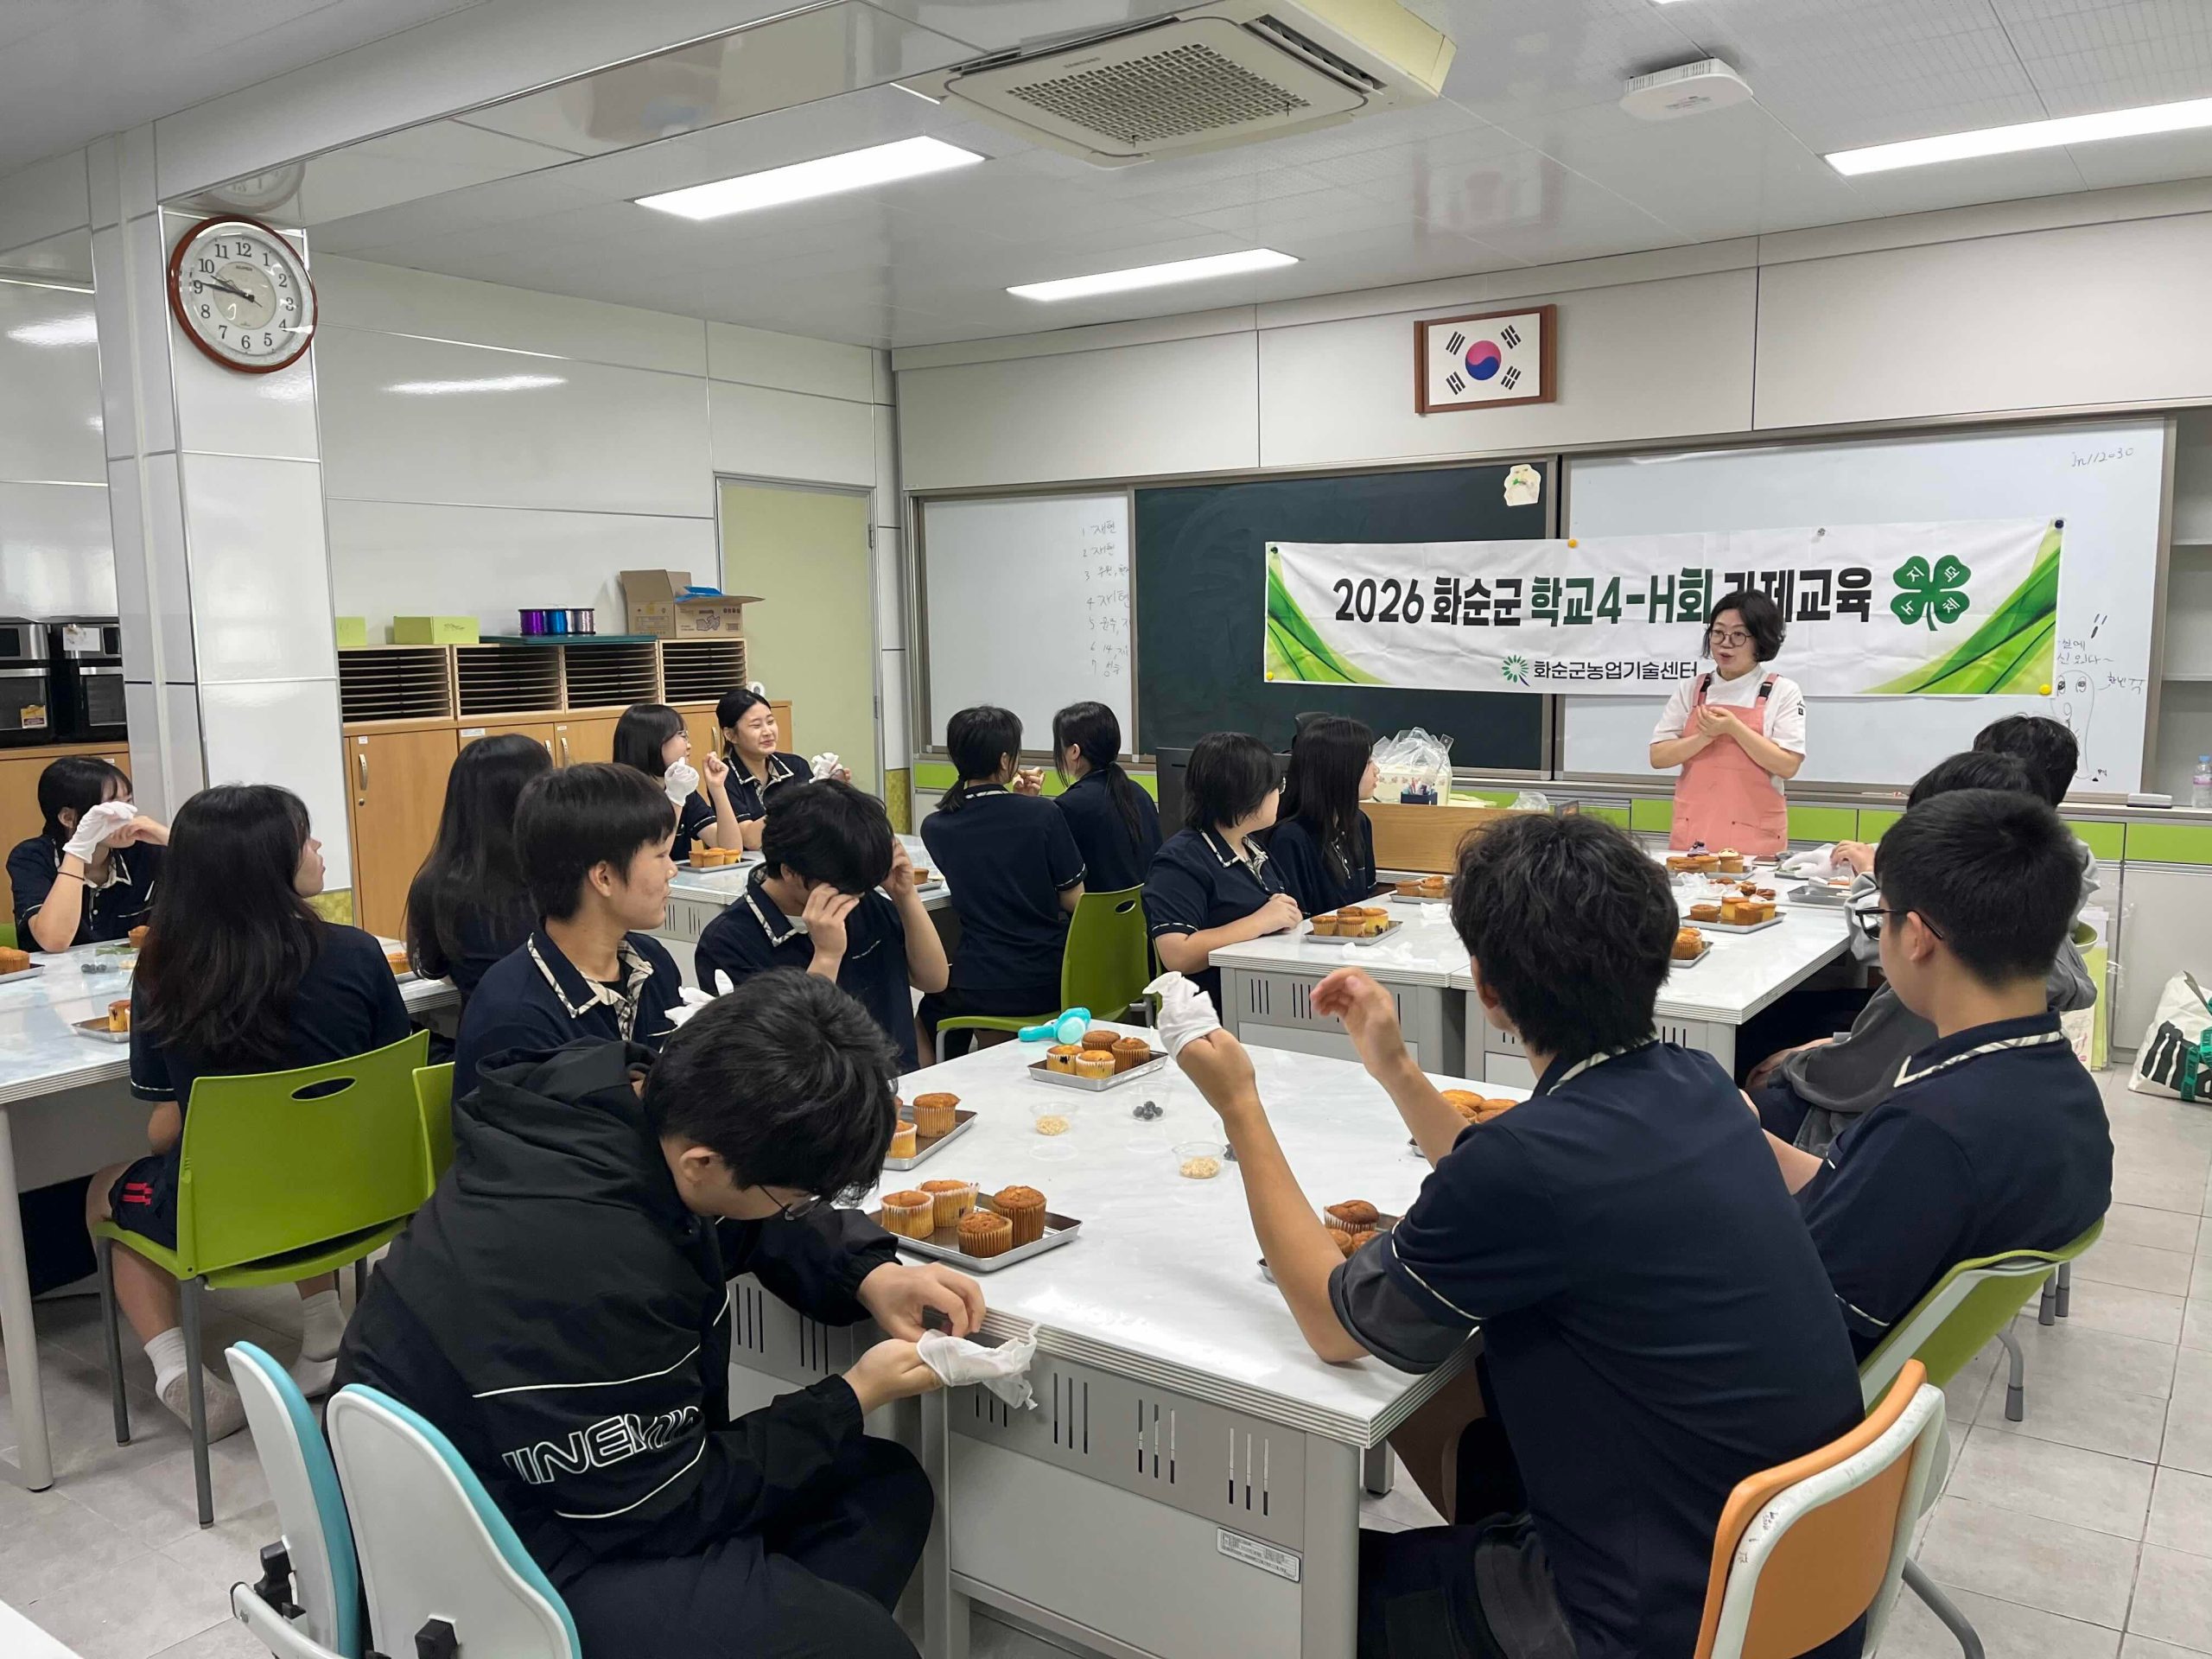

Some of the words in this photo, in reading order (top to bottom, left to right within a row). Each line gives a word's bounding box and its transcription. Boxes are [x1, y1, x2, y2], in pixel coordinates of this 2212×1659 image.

[215, 244, 230, 259] 11
[236, 242, 252, 257] 12
[199, 258, 214, 273] 10
[263, 252, 270, 266] 1
[194, 280, 203, 294] 9
[278, 274, 288, 288] 2
[201, 304, 211, 319] 8
[219, 325, 228, 340] 7
[278, 319, 287, 332] 4
[241, 335, 251, 349] 6
[264, 333, 273, 346] 5
[1906, 566, 1925, 582] 지
[1944, 566, 1960, 582] 덕
[1087, 597, 1095, 610] 4
[1333, 578, 1425, 624] 2026
[1431, 575, 1522, 626] 화순군
[1531, 567, 1713, 627] 학교4-H회
[1901, 601, 1914, 615] 노
[1942, 597, 1961, 613] 체
[1090, 616, 1095, 629] 5
[1534, 661, 1698, 680] 화순군농업기술센터
